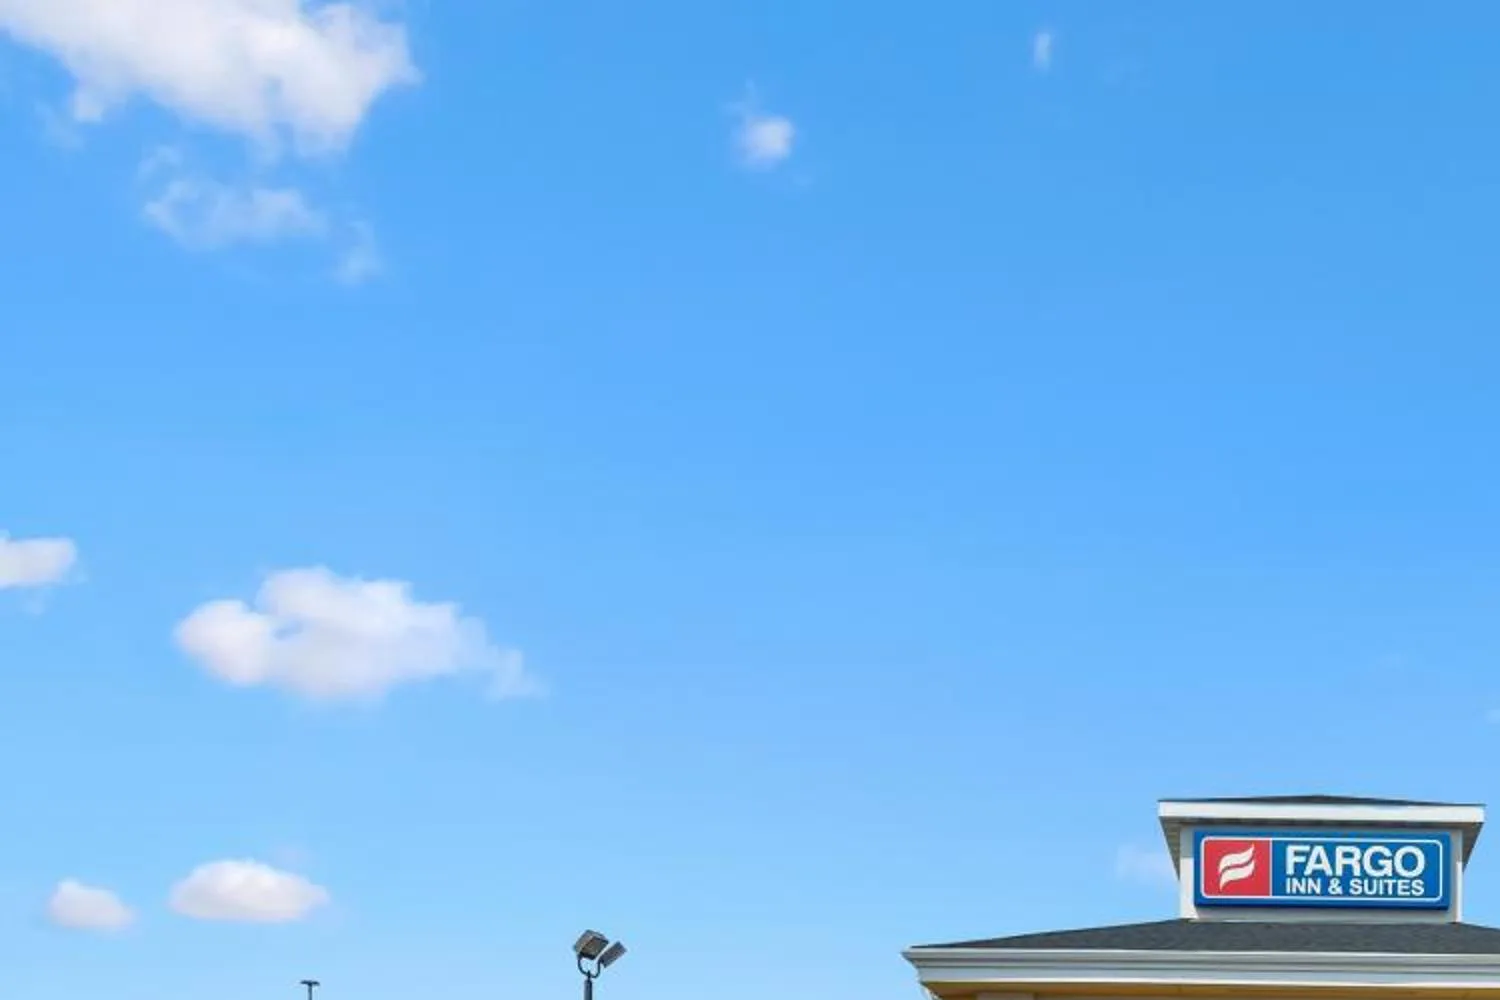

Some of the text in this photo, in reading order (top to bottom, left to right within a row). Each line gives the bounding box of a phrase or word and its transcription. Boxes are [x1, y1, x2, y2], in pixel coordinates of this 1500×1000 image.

[1286, 844, 1425, 877] FARGO
[1286, 878, 1425, 896] INN & SUITES
